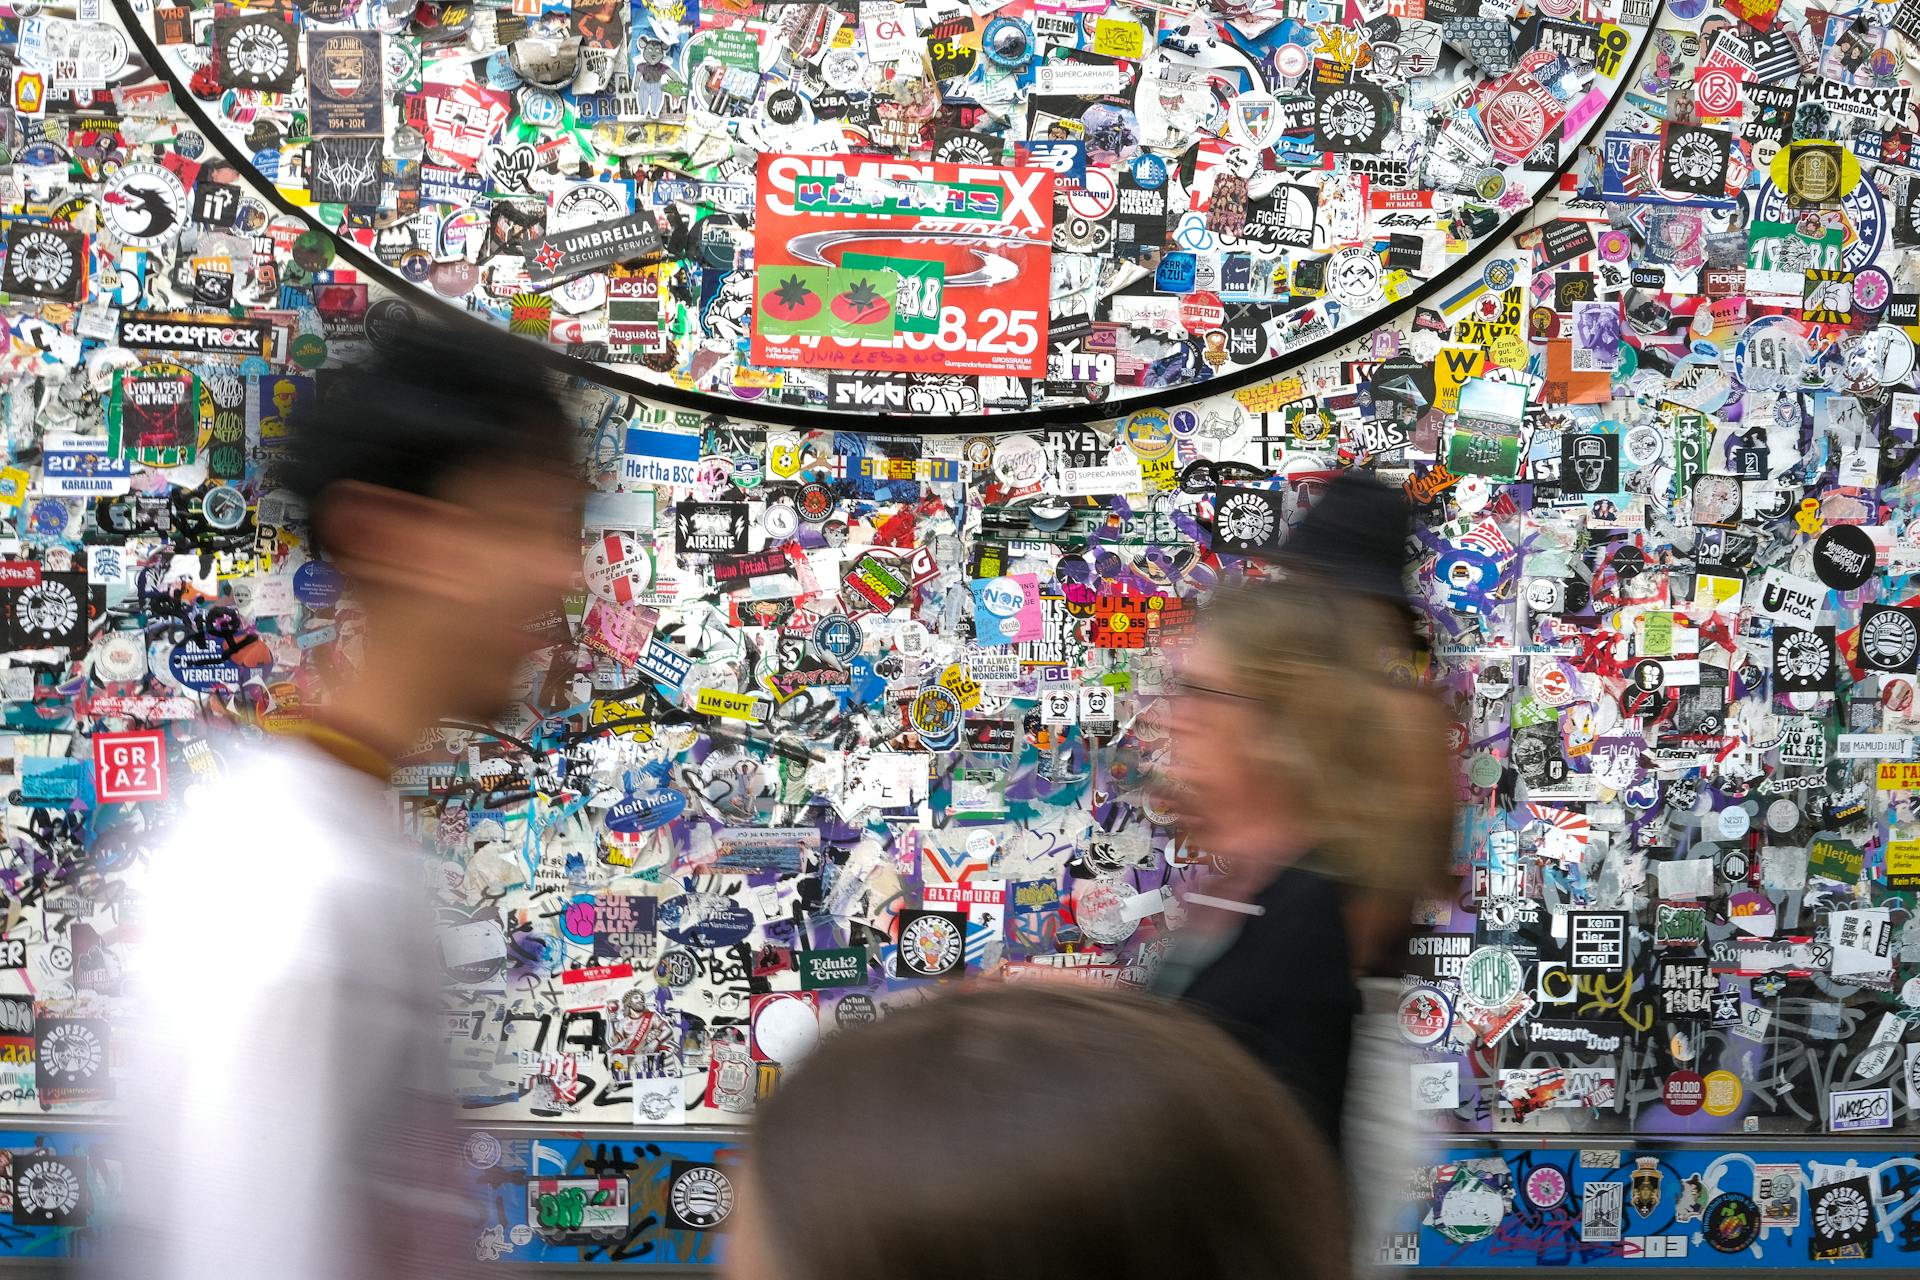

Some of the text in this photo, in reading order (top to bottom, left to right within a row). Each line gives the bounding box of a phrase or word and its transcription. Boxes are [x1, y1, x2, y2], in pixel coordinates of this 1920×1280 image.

[1037, 17, 1076, 34] DEFEND
[1718, 36, 1737, 55] GANZ
[1055, 70, 1114, 79] SUPERCARHANSI
[1515, 71, 1564, 118] 15 JAHRE
[1802, 79, 1911, 118] MCMXXI
[813, 97, 847, 108] CUBA
[1826, 101, 1879, 118] TIMISOARA
[1452, 117, 1491, 153] Sportverein
[1350, 159, 1409, 174] DANK
[1120, 189, 1161, 198] VIENNA
[1390, 192, 1417, 200] HELLO
[1120, 197, 1164, 207] HUSTLES
[1274, 200, 1286, 212] LE
[1120, 206, 1163, 216] HARDER
[1256, 211, 1286, 226] FIGHE
[565, 219, 654, 252] UMBRELLA
[1244, 222, 1312, 246] ON TOUR
[1546, 223, 1580, 238] Cruzcampo,
[1549, 229, 1588, 247] Chicharrones
[1565, 236, 1588, 250] SEVILLA
[569, 235, 658, 265] SECURITY SERVICE
[609, 276, 658, 298] Legio
[1892, 304, 1917, 317] HAUZ
[124, 323, 193, 345] SCHOOL
[207, 328, 260, 349] ROCK
[609, 326, 657, 342] Augusta
[1284, 328, 1331, 352] ADVENTURERS
[1497, 341, 1517, 349] Ernte
[1016, 363, 1032, 371] Wien
[159, 382, 185, 394] 1950
[135, 394, 151, 405] ON
[152, 394, 173, 405] FIRE
[48, 456, 125, 471] 20 24
[860, 458, 949, 480] STRESSATI
[626, 460, 695, 485] Hertha BSC
[1078, 469, 1137, 481] SUPERCARHANSI
[62, 480, 113, 492] KARALLADA
[686, 537, 735, 550] AIRLINE
[1783, 604, 1813, 621] HOCA
[1097, 618, 1146, 629] 19 65
[826, 632, 850, 643] LTCC
[972, 656, 1018, 666] I'M ALWAYS
[1018, 649, 1064, 663] ULTRAS
[972, 664, 1010, 673] NOTICING
[182, 667, 239, 684] VERGLEICH
[972, 672, 1018, 681] WONDERING
[700, 696, 722, 708] LIM
[1054, 702, 1066, 711] 20
[1092, 698, 1104, 707] 20
[1785, 734, 1801, 745] TO
[114, 746, 146, 767] GR
[115, 767, 147, 787] AZ
[1773, 775, 1828, 793] SHPOCK
[613, 799, 644, 818] Nett
[1893, 877, 1908, 886] Kein
[929, 888, 1001, 904] ALTAMURA
[594, 920, 637, 933] ALLY
[1587, 917, 1615, 928] kein
[1581, 931, 1604, 941] tier
[1409, 937, 1471, 956] OSTBAHN
[1597, 942, 1614, 952] ist
[1580, 953, 1609, 965] egal
[839, 1002, 853, 1012] do
[846, 996, 866, 1005] what
[1664, 989, 1712, 1014] 1964
[1586, 1033, 1620, 1051] Drop
[1669, 1081, 1701, 1093] 80.000
